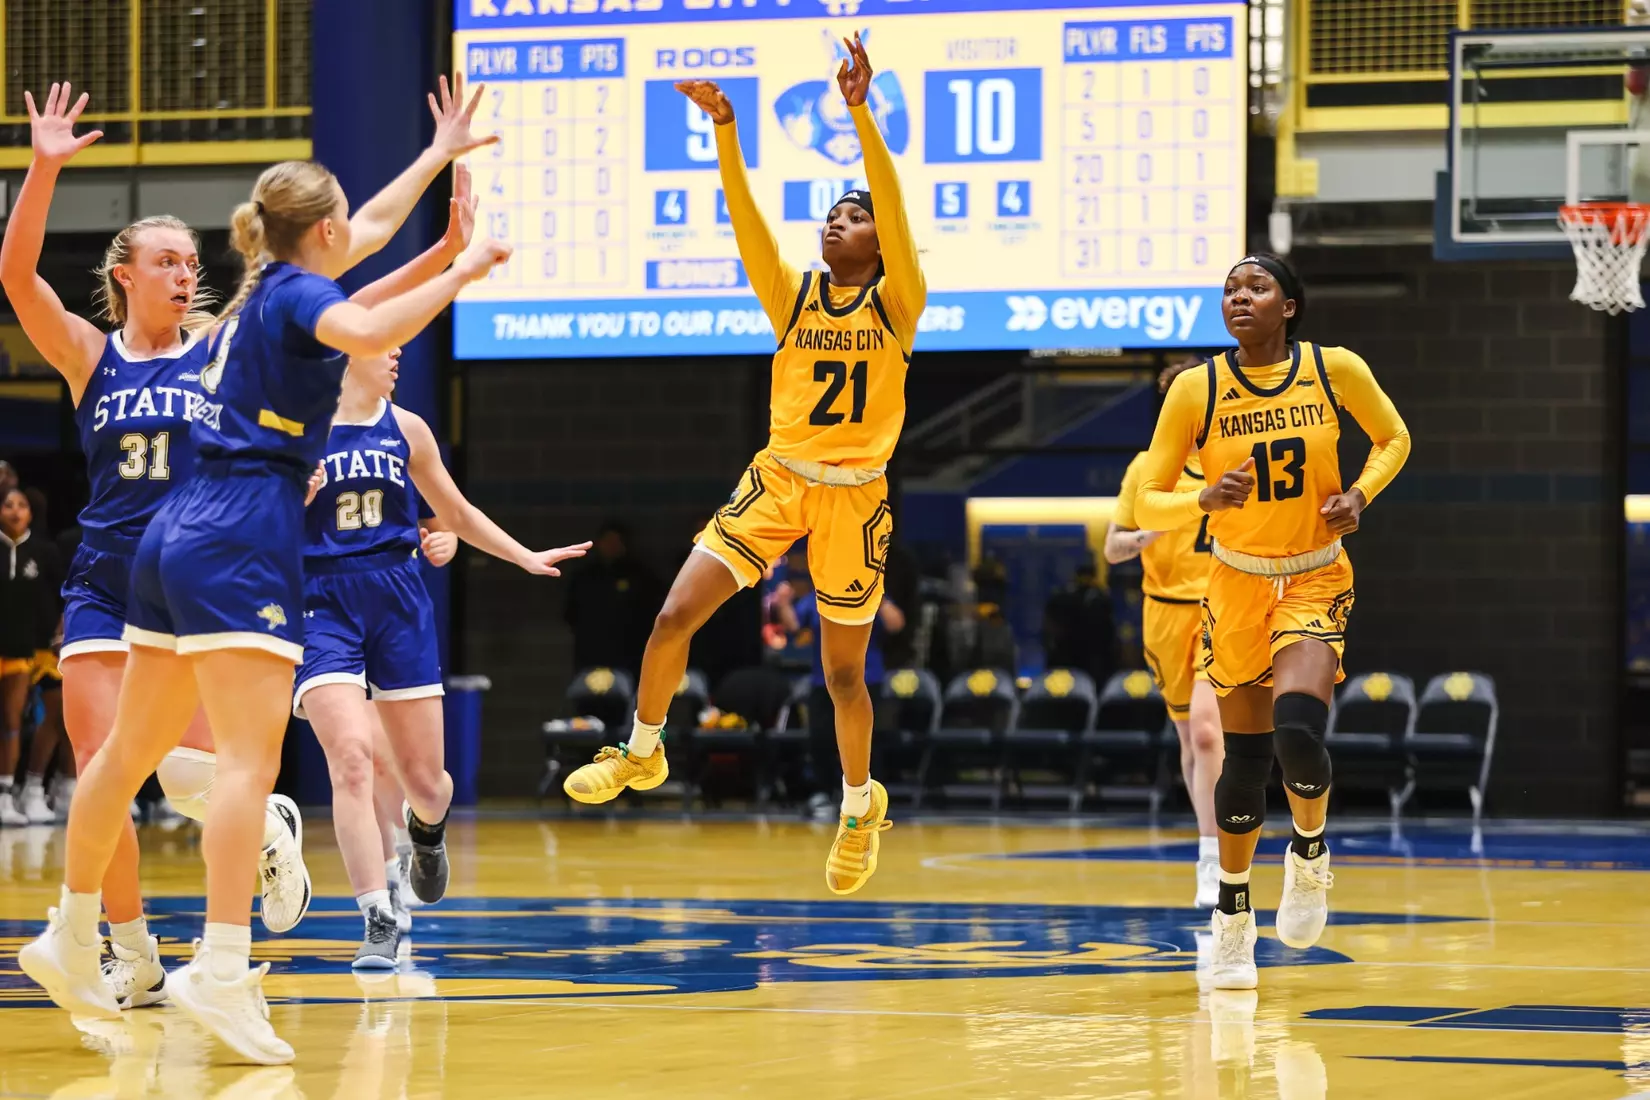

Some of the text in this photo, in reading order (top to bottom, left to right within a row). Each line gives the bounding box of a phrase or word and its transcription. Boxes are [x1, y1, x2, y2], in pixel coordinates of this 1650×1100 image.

[1065, 23, 1226, 56] PLYR FLS PTS
[468, 44, 618, 75] PLYR FLS PTS
[656, 47, 755, 68] ROOS
[1194, 66, 1210, 96] 0
[543, 86, 558, 115] 0
[948, 78, 1015, 156] 10
[1082, 108, 1208, 141] 5 0 0
[543, 128, 558, 156] 0
[543, 168, 558, 196] 0
[598, 167, 611, 195] 0
[1073, 153, 1104, 184] 20
[1137, 153, 1152, 183] 0
[662, 191, 683, 222] 4
[941, 184, 960, 215] 5
[1002, 182, 1023, 213] 4
[543, 210, 557, 239] 0
[596, 209, 609, 238] 0
[543, 249, 558, 278] 0
[1138, 237, 1153, 267] 0
[1193, 236, 1208, 266] 0
[658, 260, 738, 288] BONUS
[493, 313, 575, 340] THANK
[576, 311, 627, 338] YOU
[627, 310, 661, 337] TO
[662, 310, 714, 336] OUR
[1051, 295, 1203, 341] evergy
[795, 328, 884, 351] KANSAS CITY
[809, 360, 868, 426] 21
[1219, 403, 1324, 438] KANSAS CITY
[119, 431, 170, 480] 31
[1250, 436, 1306, 502] 13
[336, 489, 384, 531] 20
